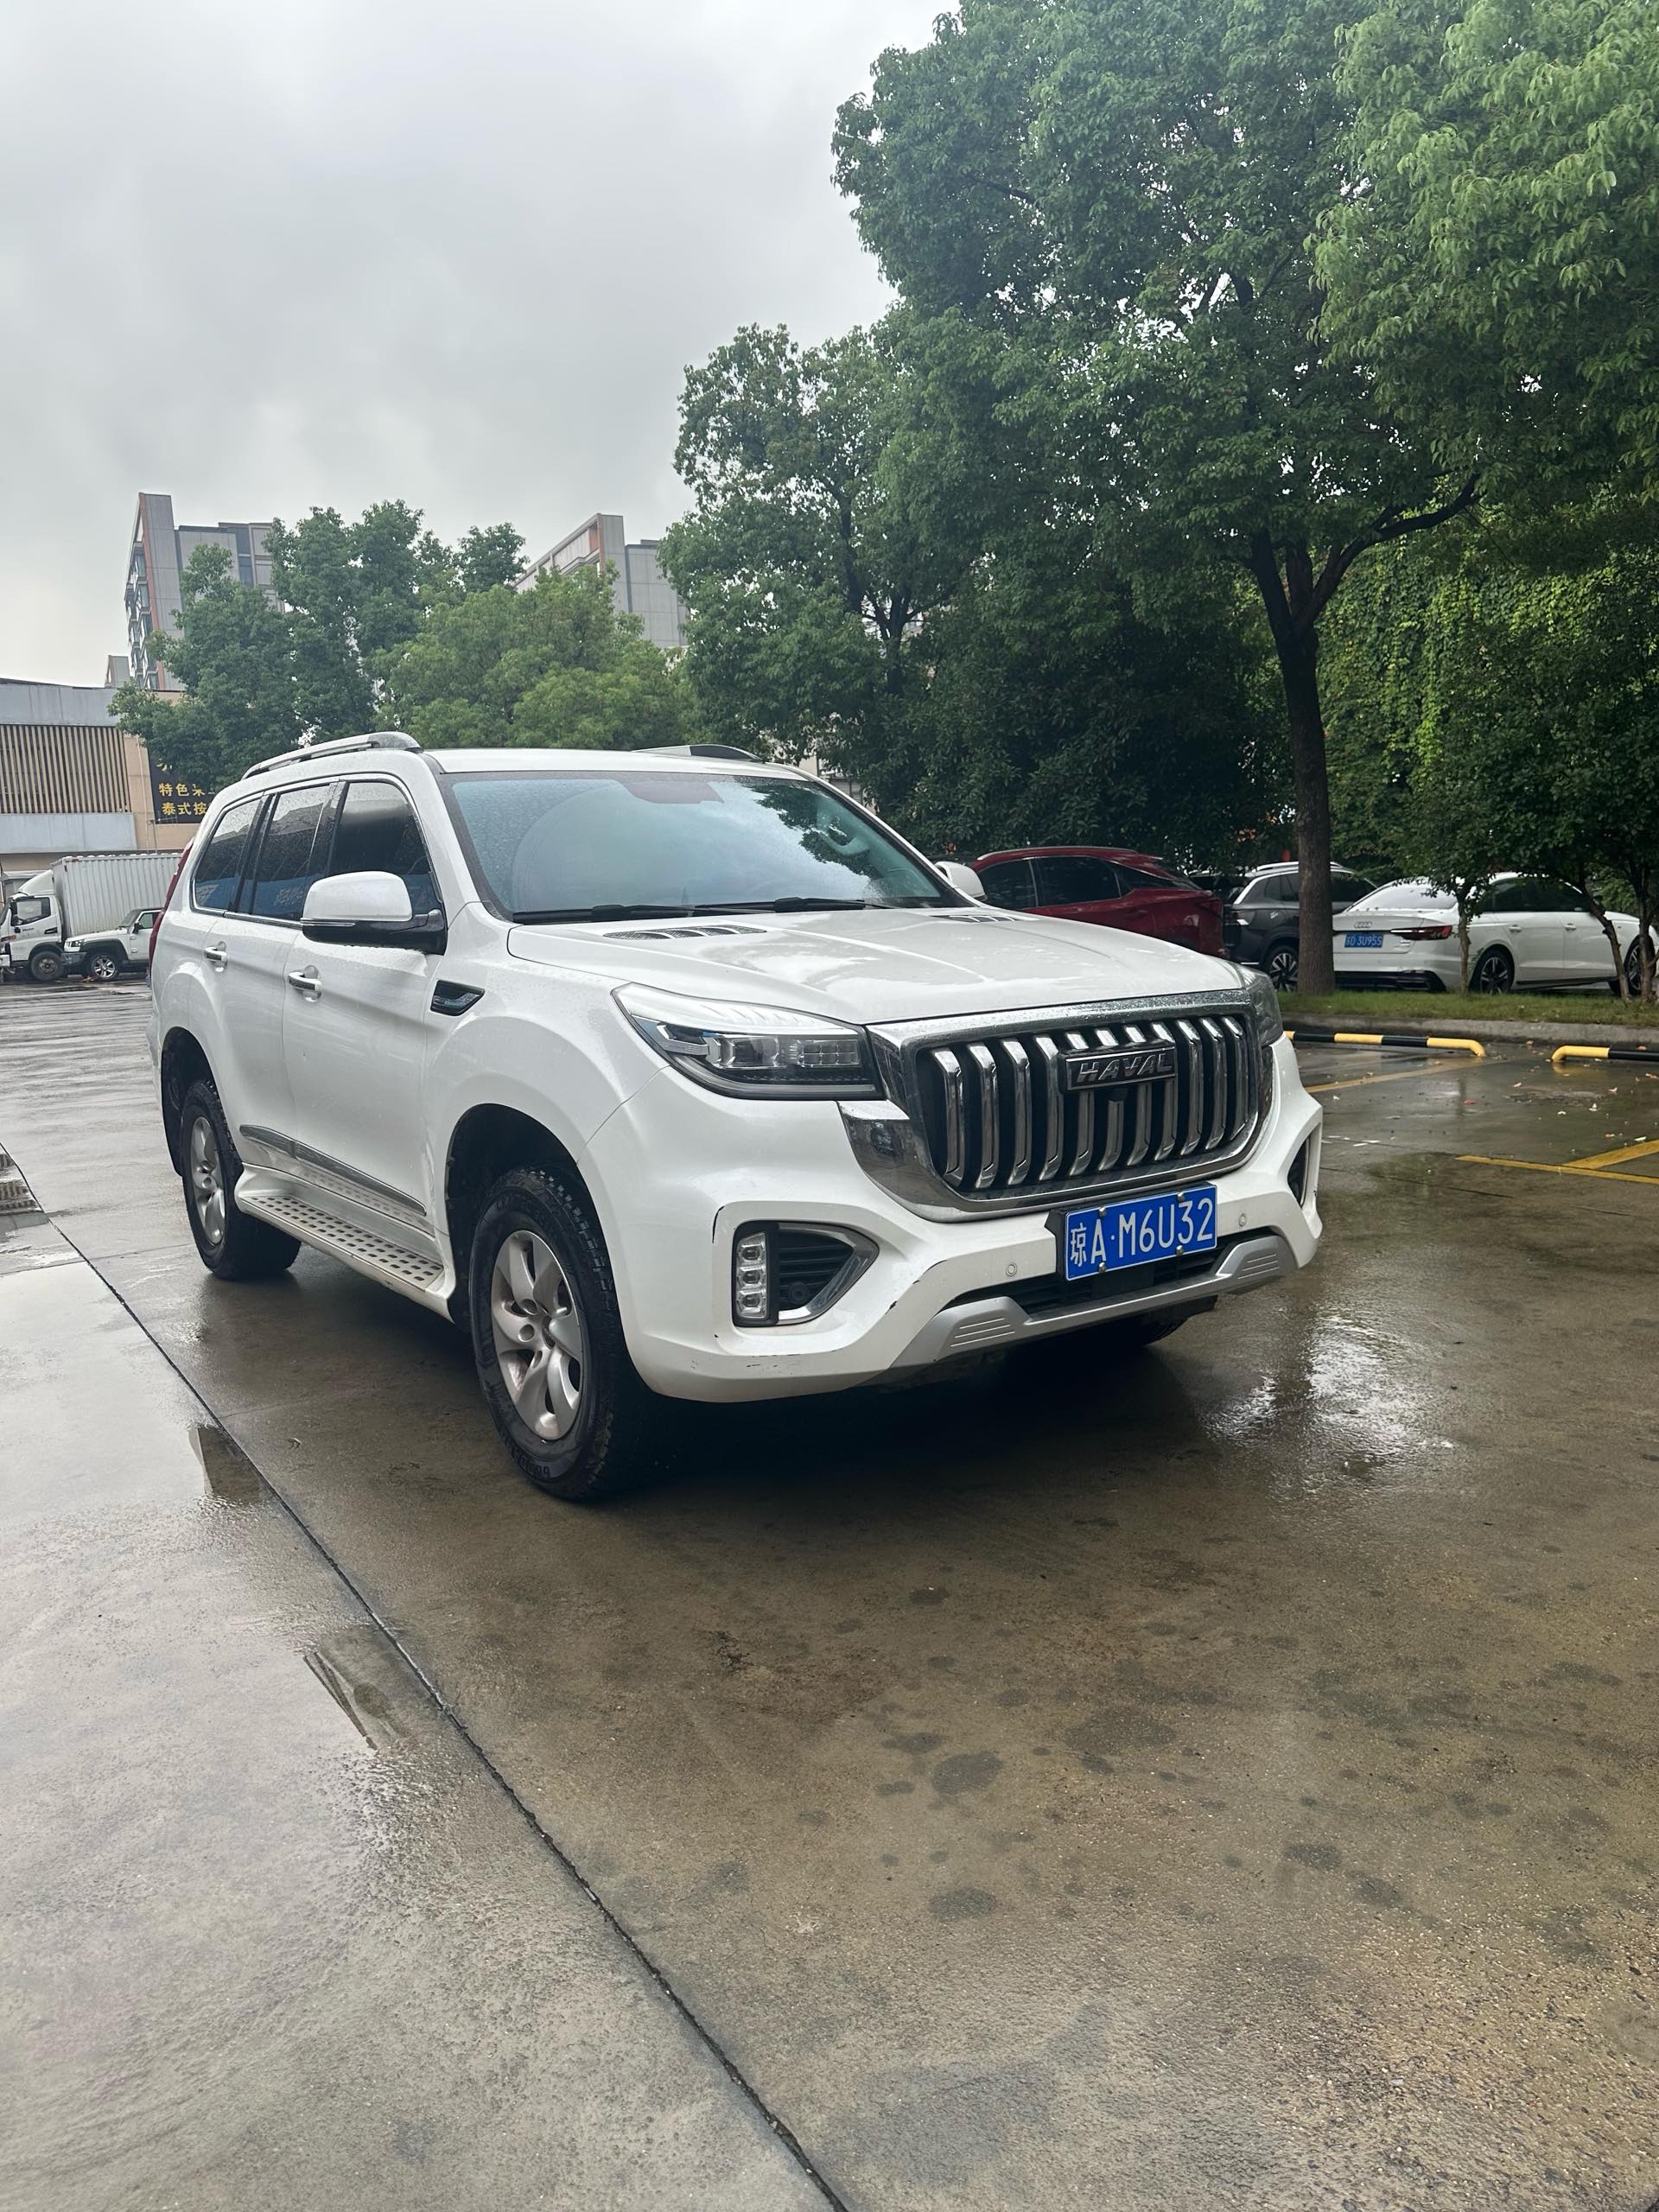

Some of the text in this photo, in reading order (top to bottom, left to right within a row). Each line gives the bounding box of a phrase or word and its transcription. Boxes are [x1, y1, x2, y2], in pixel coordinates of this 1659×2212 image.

[162, 801, 211, 816] 泰式按
[1077, 1052, 1173, 1083] HAVAL
[1071, 1198, 1213, 1268] 琼A·M6U32
